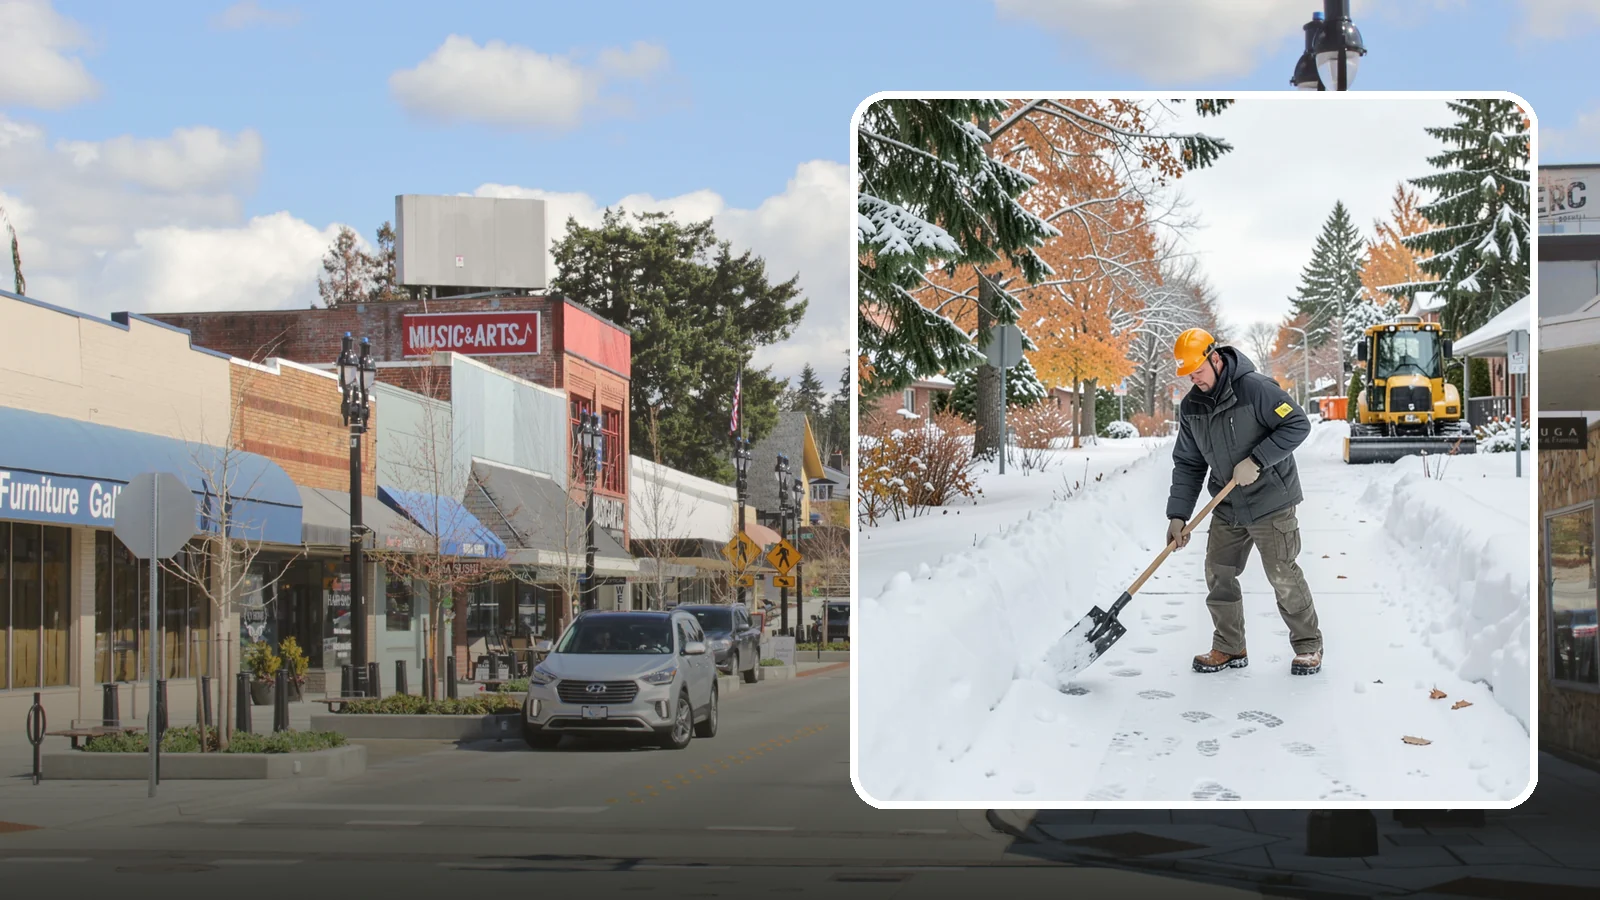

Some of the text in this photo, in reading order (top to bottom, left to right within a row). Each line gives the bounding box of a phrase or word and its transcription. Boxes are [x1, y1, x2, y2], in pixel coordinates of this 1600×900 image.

[409, 323, 519, 349] MUSIC&ARTS
[0, 472, 122, 519] Furniture Gal
[453, 563, 480, 574] SUSHI
